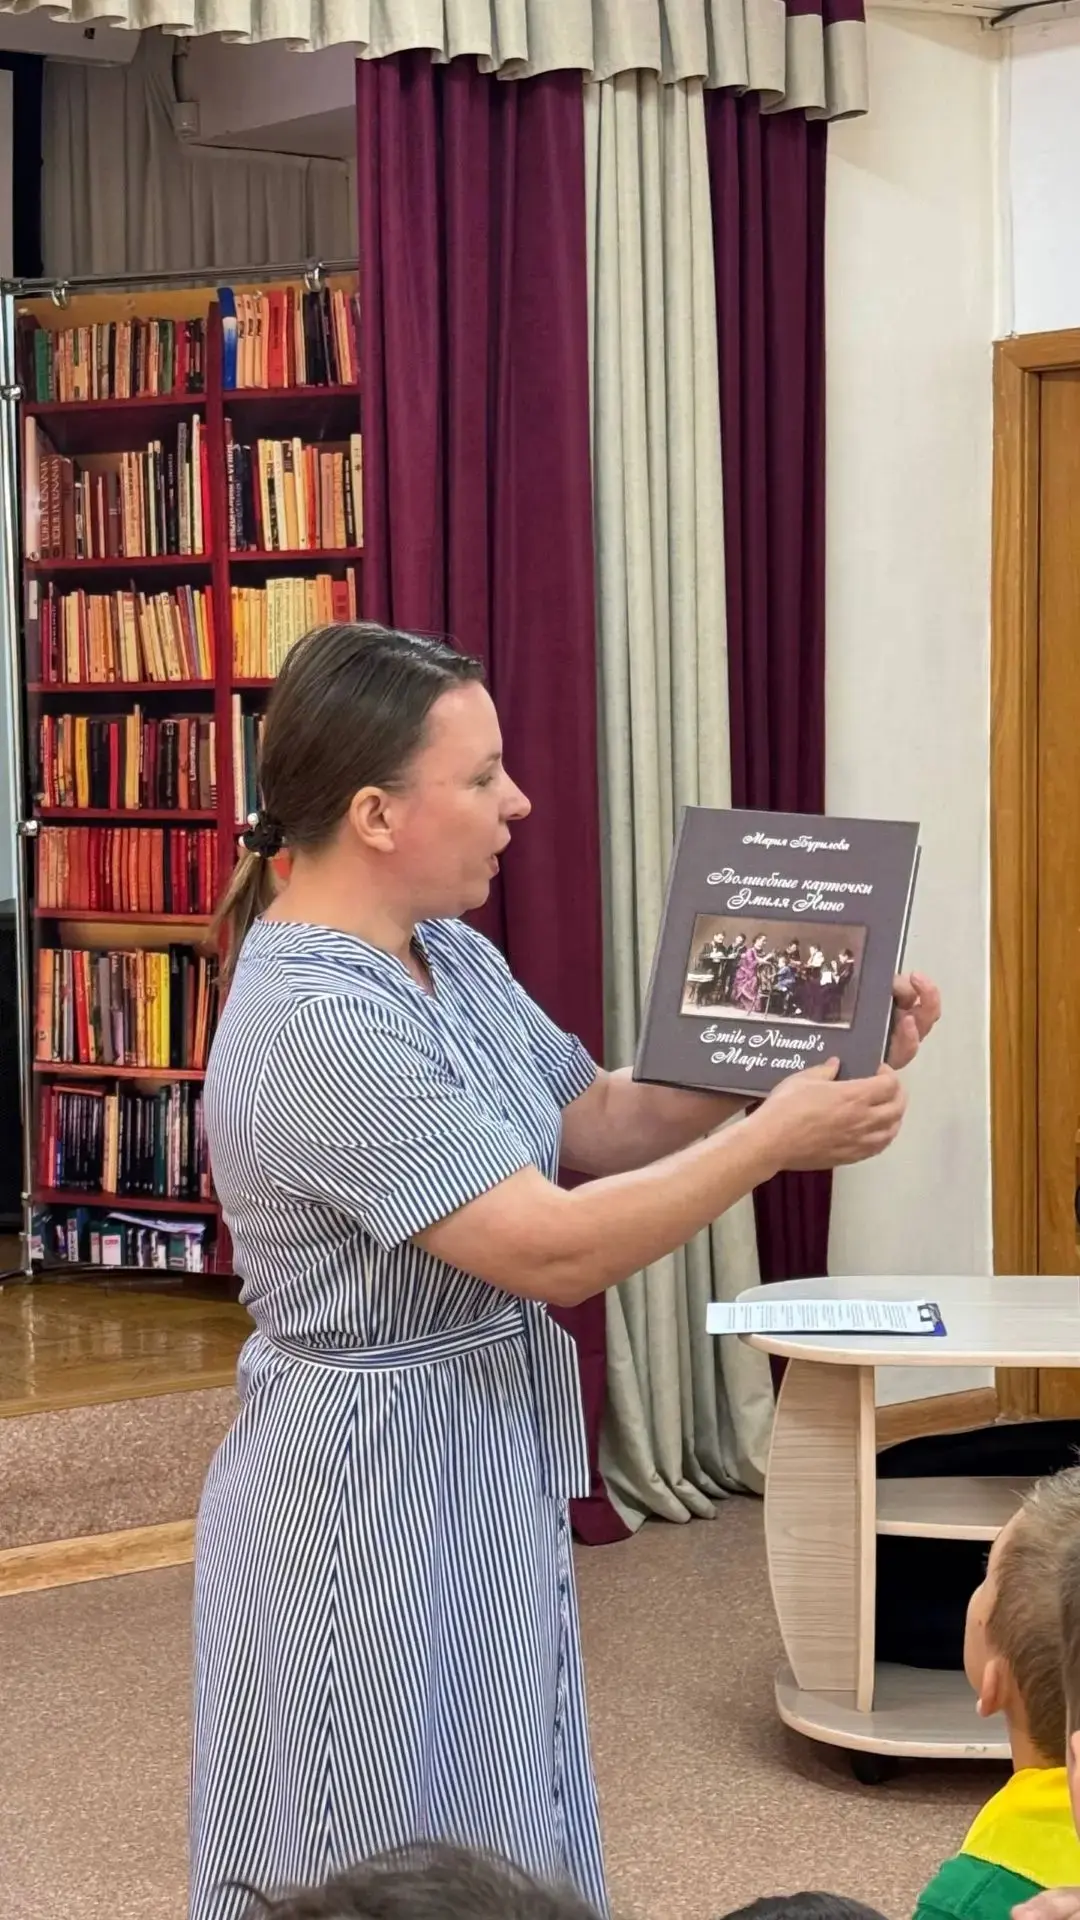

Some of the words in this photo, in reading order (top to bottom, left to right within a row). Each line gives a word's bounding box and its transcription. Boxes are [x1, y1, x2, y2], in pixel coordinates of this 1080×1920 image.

[742, 831, 787, 850] Мария
[706, 867, 799, 889] Волшебные
[801, 878, 874, 896] карточки
[726, 887, 791, 910] Эмиля
[792, 892, 845, 912] Нино
[700, 1024, 746, 1043] Emile
[748, 1029, 825, 1052] Ninaud's
[710, 1046, 769, 1072] Magic
[770, 1053, 806, 1071] cards
